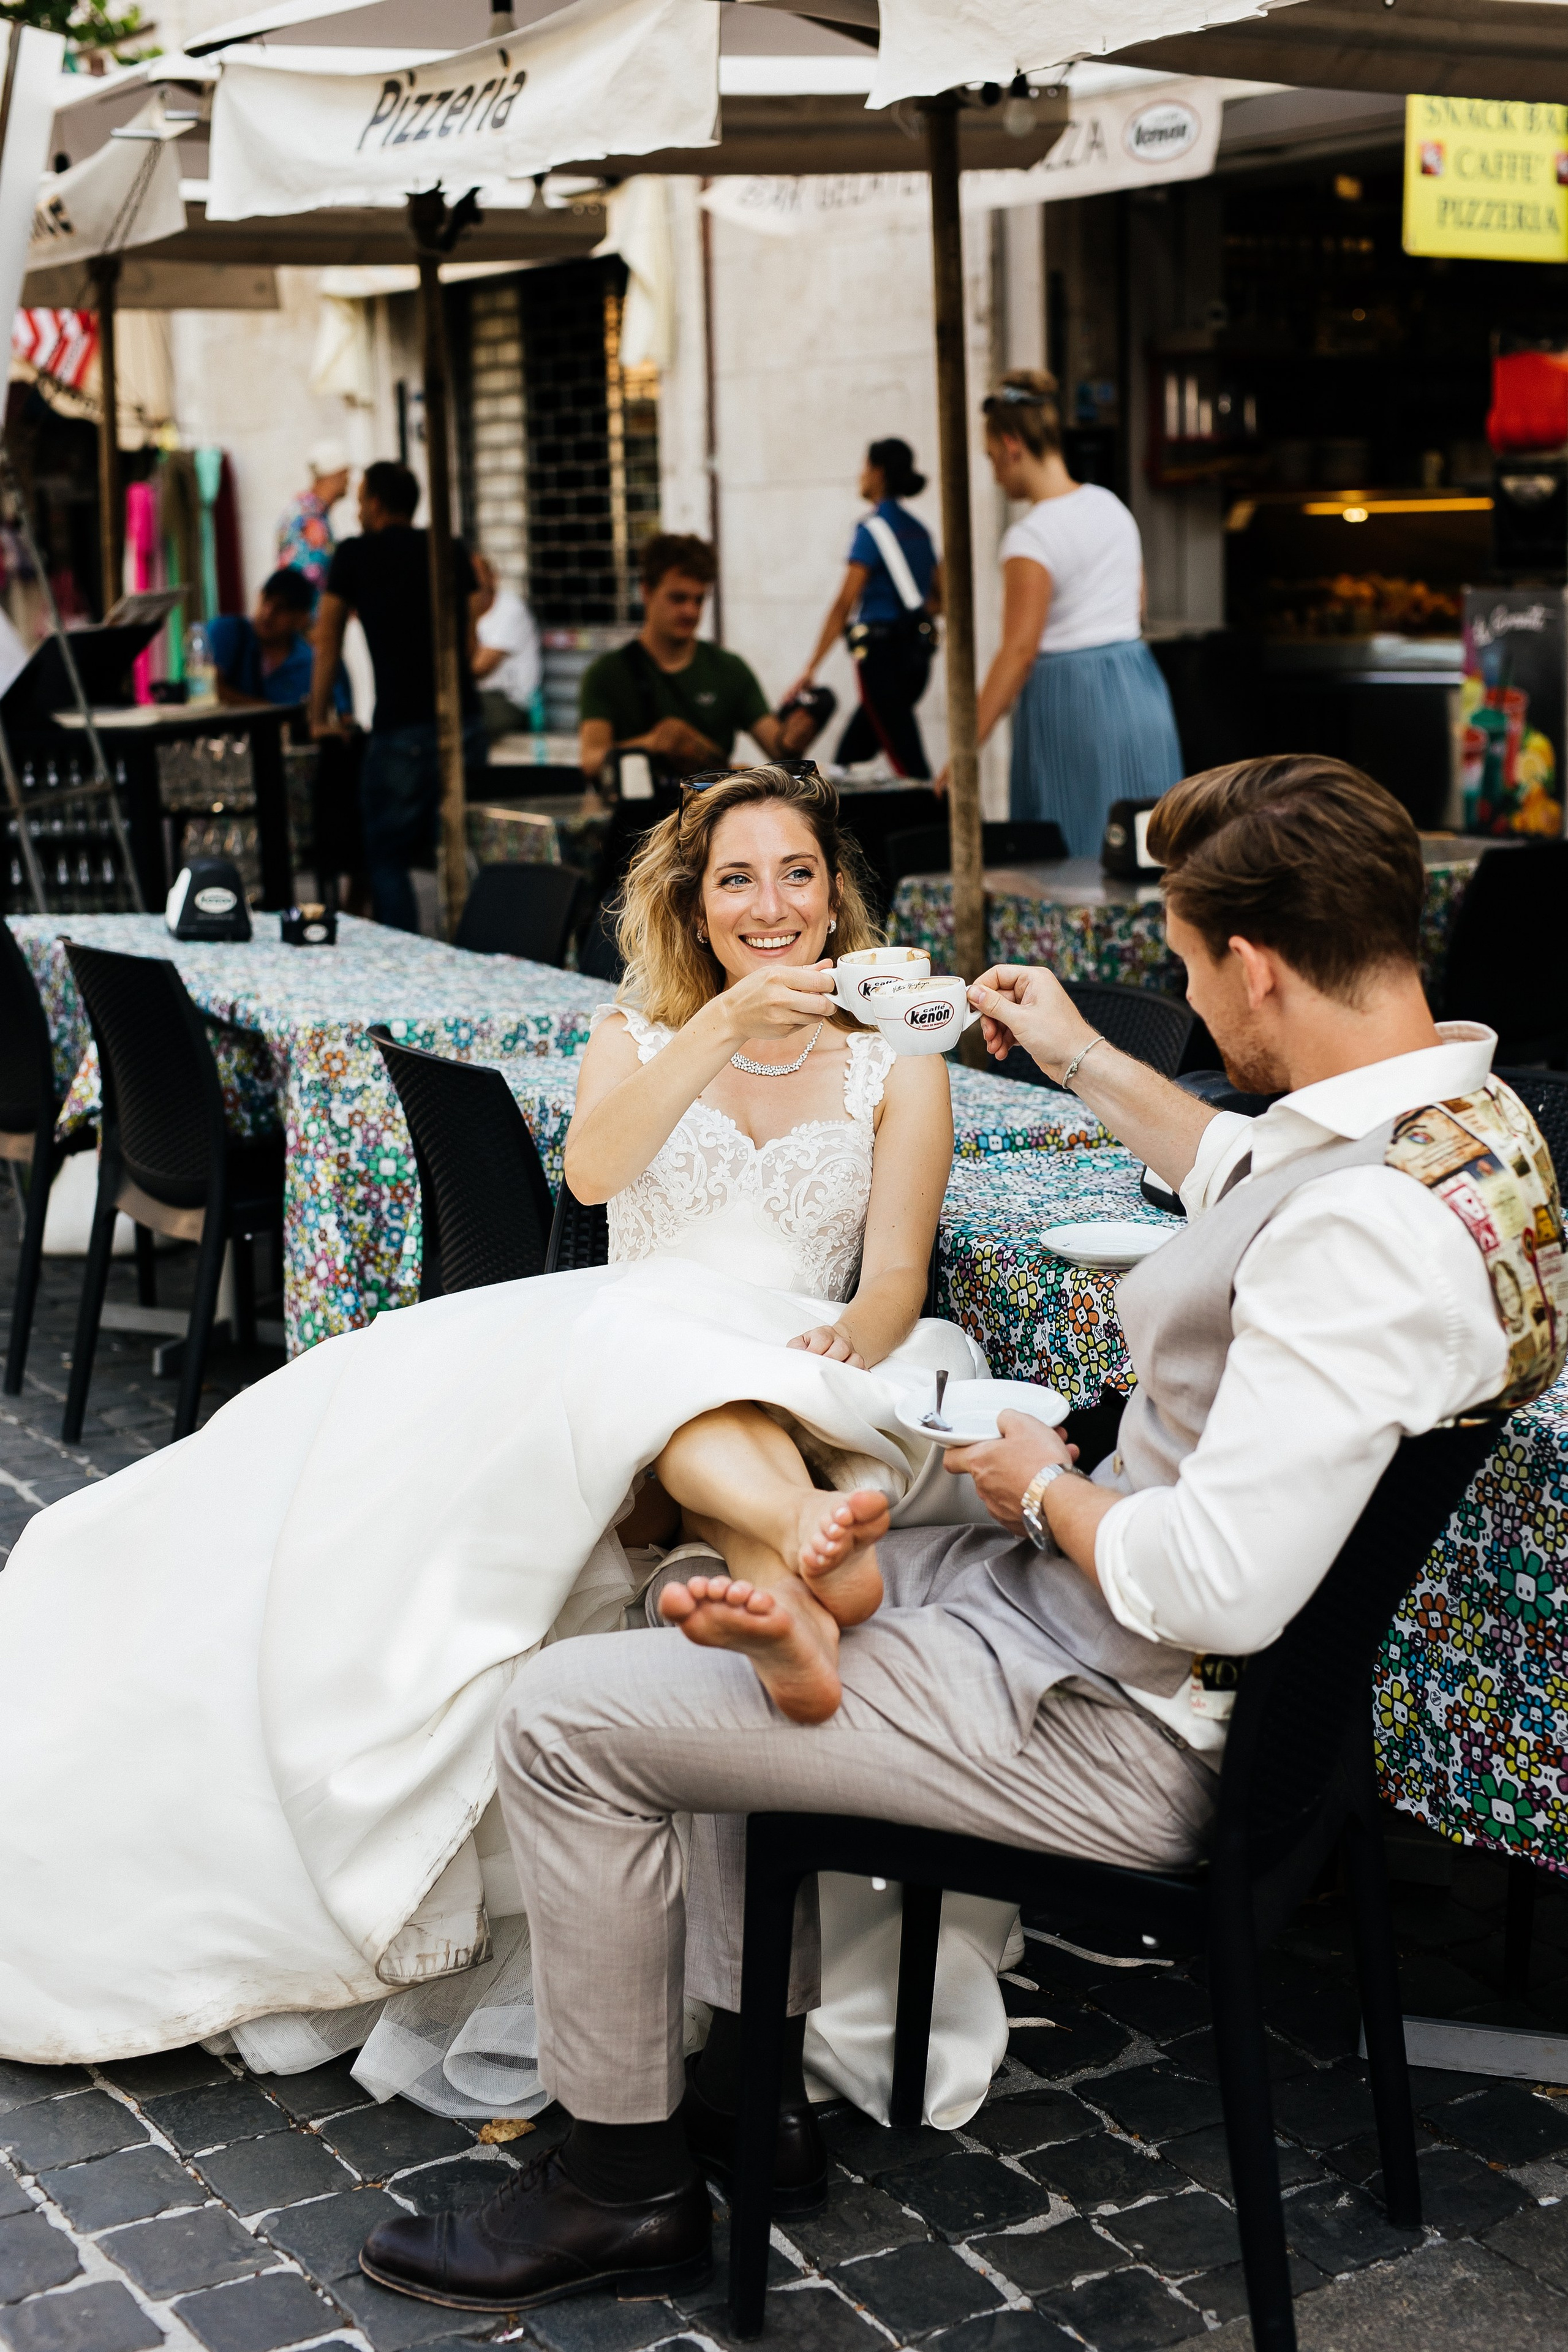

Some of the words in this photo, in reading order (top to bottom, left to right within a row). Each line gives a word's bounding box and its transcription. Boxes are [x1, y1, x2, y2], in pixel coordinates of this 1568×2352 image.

[357, 47, 527, 150] Pizzeria
[1523, 103, 1568, 135] BA
[1438, 195, 1560, 233] PIZZERIA
[910, 1009, 950, 1025] kenon
